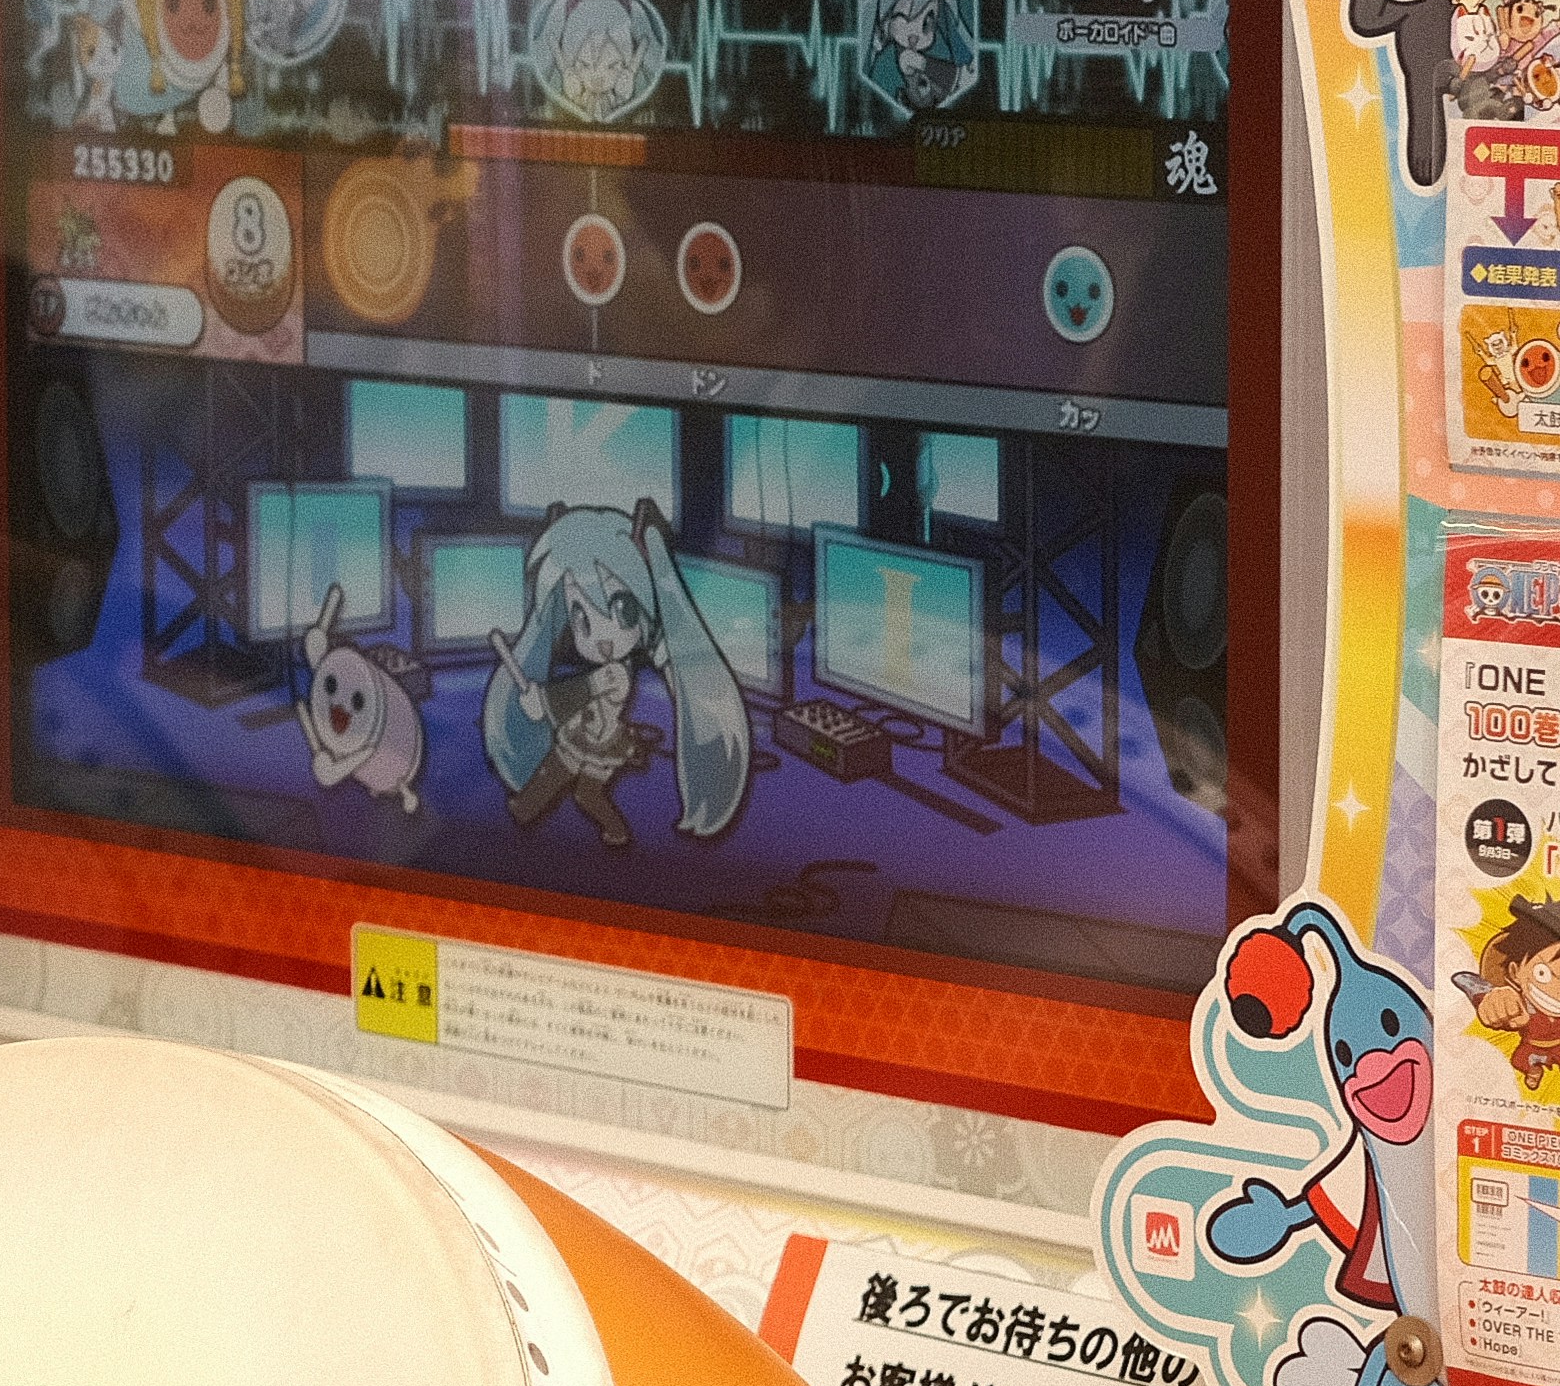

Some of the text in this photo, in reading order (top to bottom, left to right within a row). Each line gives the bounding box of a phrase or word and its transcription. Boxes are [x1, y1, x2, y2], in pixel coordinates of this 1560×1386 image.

[73, 143, 174, 183] 255330
[1164, 130, 1219, 197] 魂
[232, 192, 268, 256] 8
[1488, 263, 1558, 289] 結果発表
[1463, 752, 1558, 787] かざして
[1472, 1137, 1481, 1154] 1
